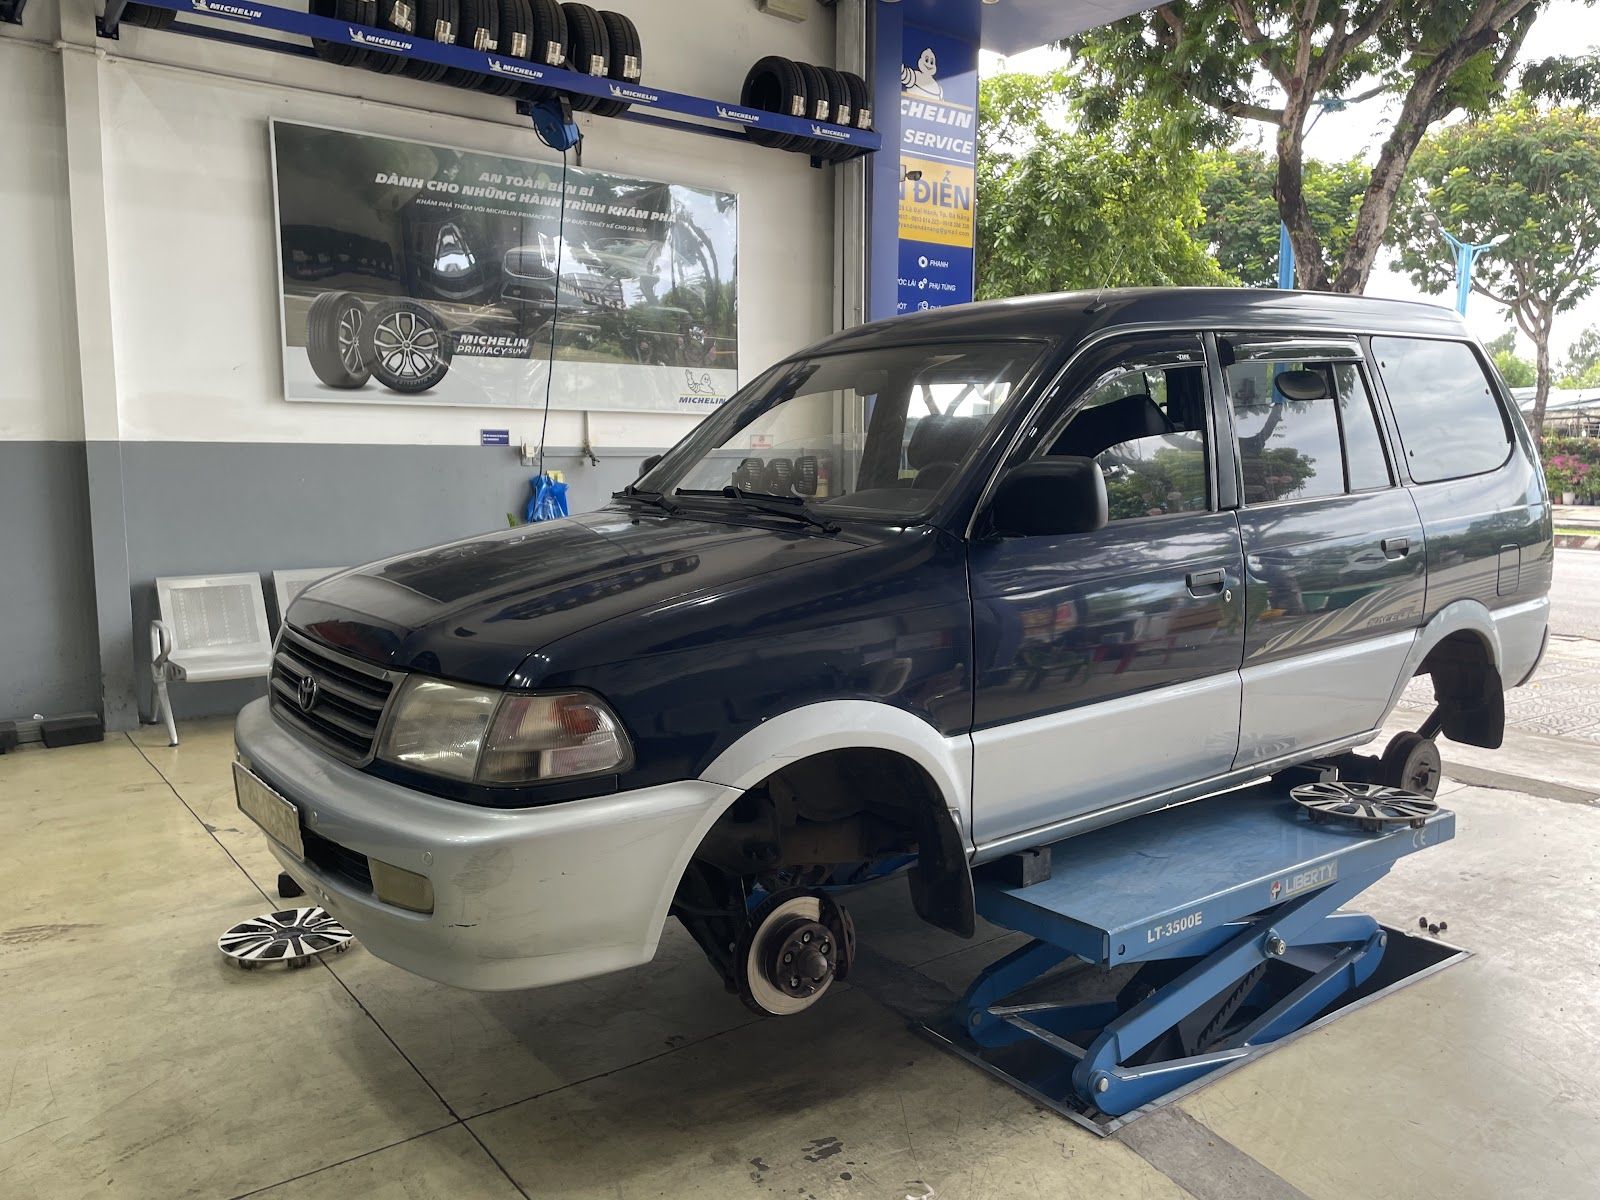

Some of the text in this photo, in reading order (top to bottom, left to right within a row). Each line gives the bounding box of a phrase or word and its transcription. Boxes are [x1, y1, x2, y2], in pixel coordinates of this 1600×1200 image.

[209, 3, 262, 18] MICHELIN
[366, 34, 412, 50] MICHELIN
[502, 64, 543, 78] MICHELIN
[622, 89, 658, 102] MICHELIN
[727, 110, 760, 122] MICHELIN
[822, 128, 850, 139] MICHELIN
[903, 129, 974, 155] SERVICE
[478, 171, 502, 184] AN
[505, 174, 545, 190] TOÀN
[375, 172, 424, 190] DÀNH
[426, 180, 459, 194] CHO
[461, 184, 517, 202] NHỮNG
[519, 192, 561, 208] HÀNH
[564, 197, 606, 215] TRÌNH
[607, 203, 649, 219] KHÁM
[914, 170, 970, 211] ĐIỂN
[485, 207, 518, 217] MICHELIN
[615, 223, 627, 231] CHO
[929, 259, 949, 268] PHANH
[928, 282, 940, 290] PHỤ
[459, 334, 529, 347] MICHELIN
[456, 345, 508, 355] PRIMACY
[678, 396, 727, 405] MICHELIN
[1285, 862, 1335, 894] LIBERTY
[1147, 911, 1202, 944] LT-3500E
